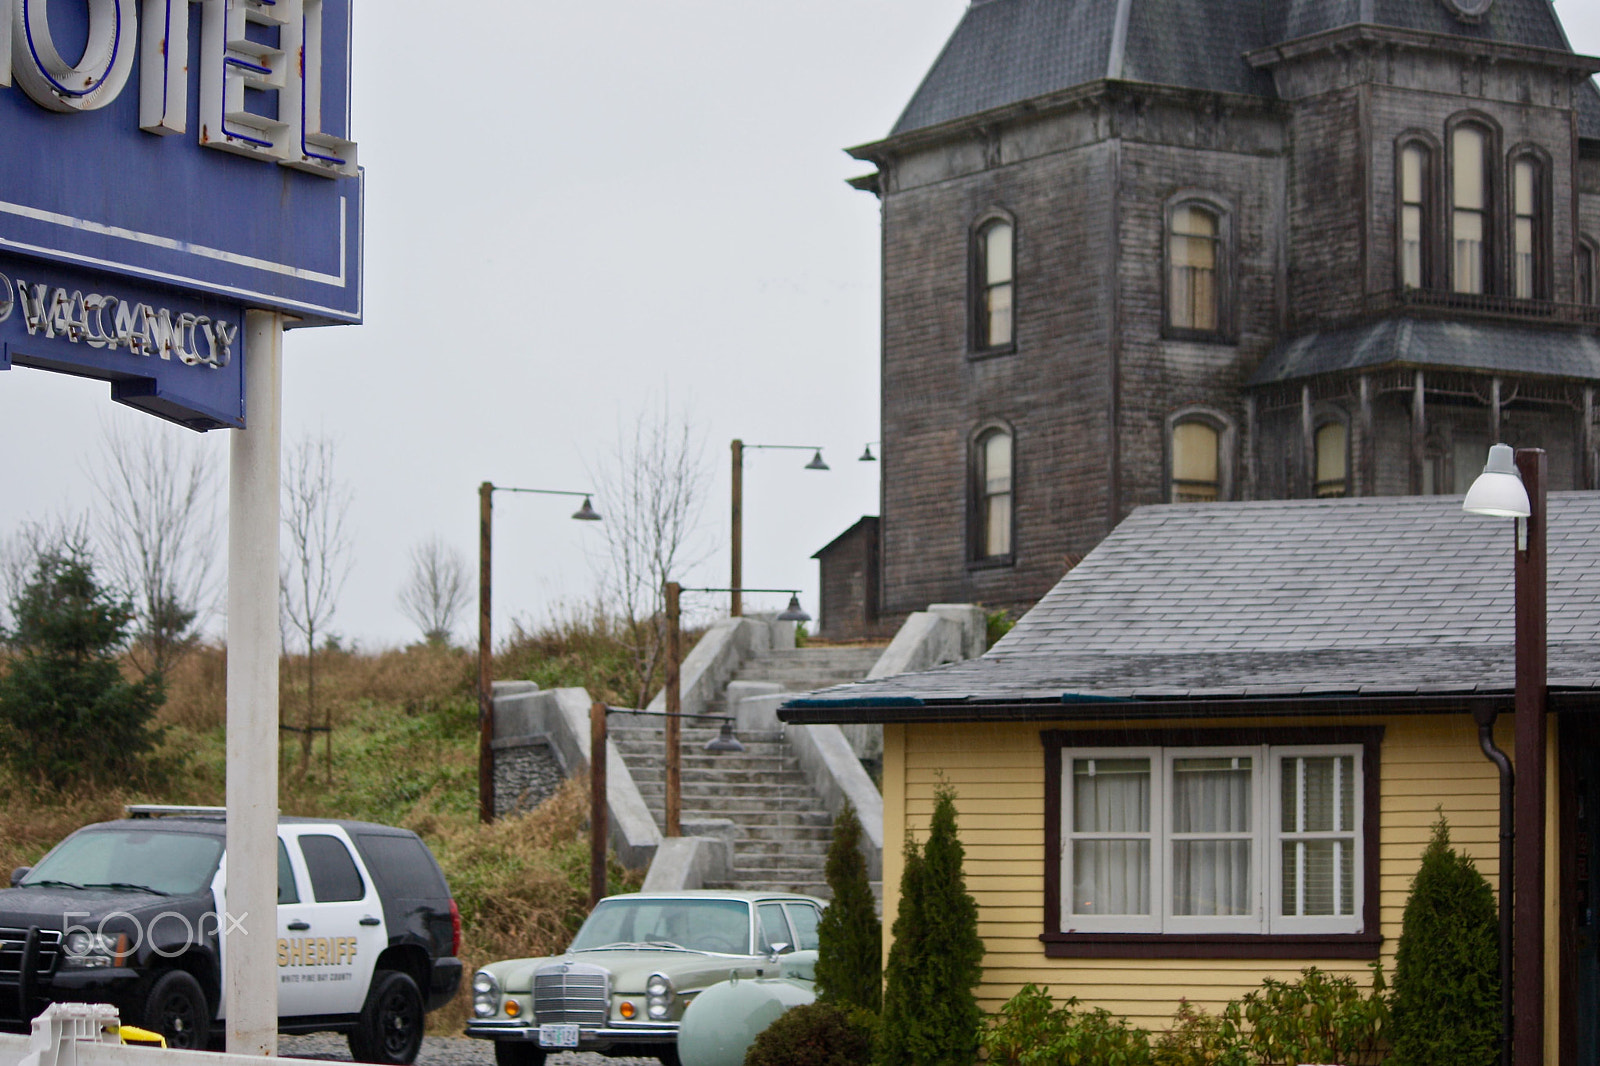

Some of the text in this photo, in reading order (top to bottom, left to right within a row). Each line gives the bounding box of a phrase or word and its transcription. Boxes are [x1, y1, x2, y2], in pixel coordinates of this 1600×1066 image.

[0, 0, 358, 179] OTEL
[16, 279, 237, 370] VACANCY
[277, 937, 357, 967] SHERIFF
